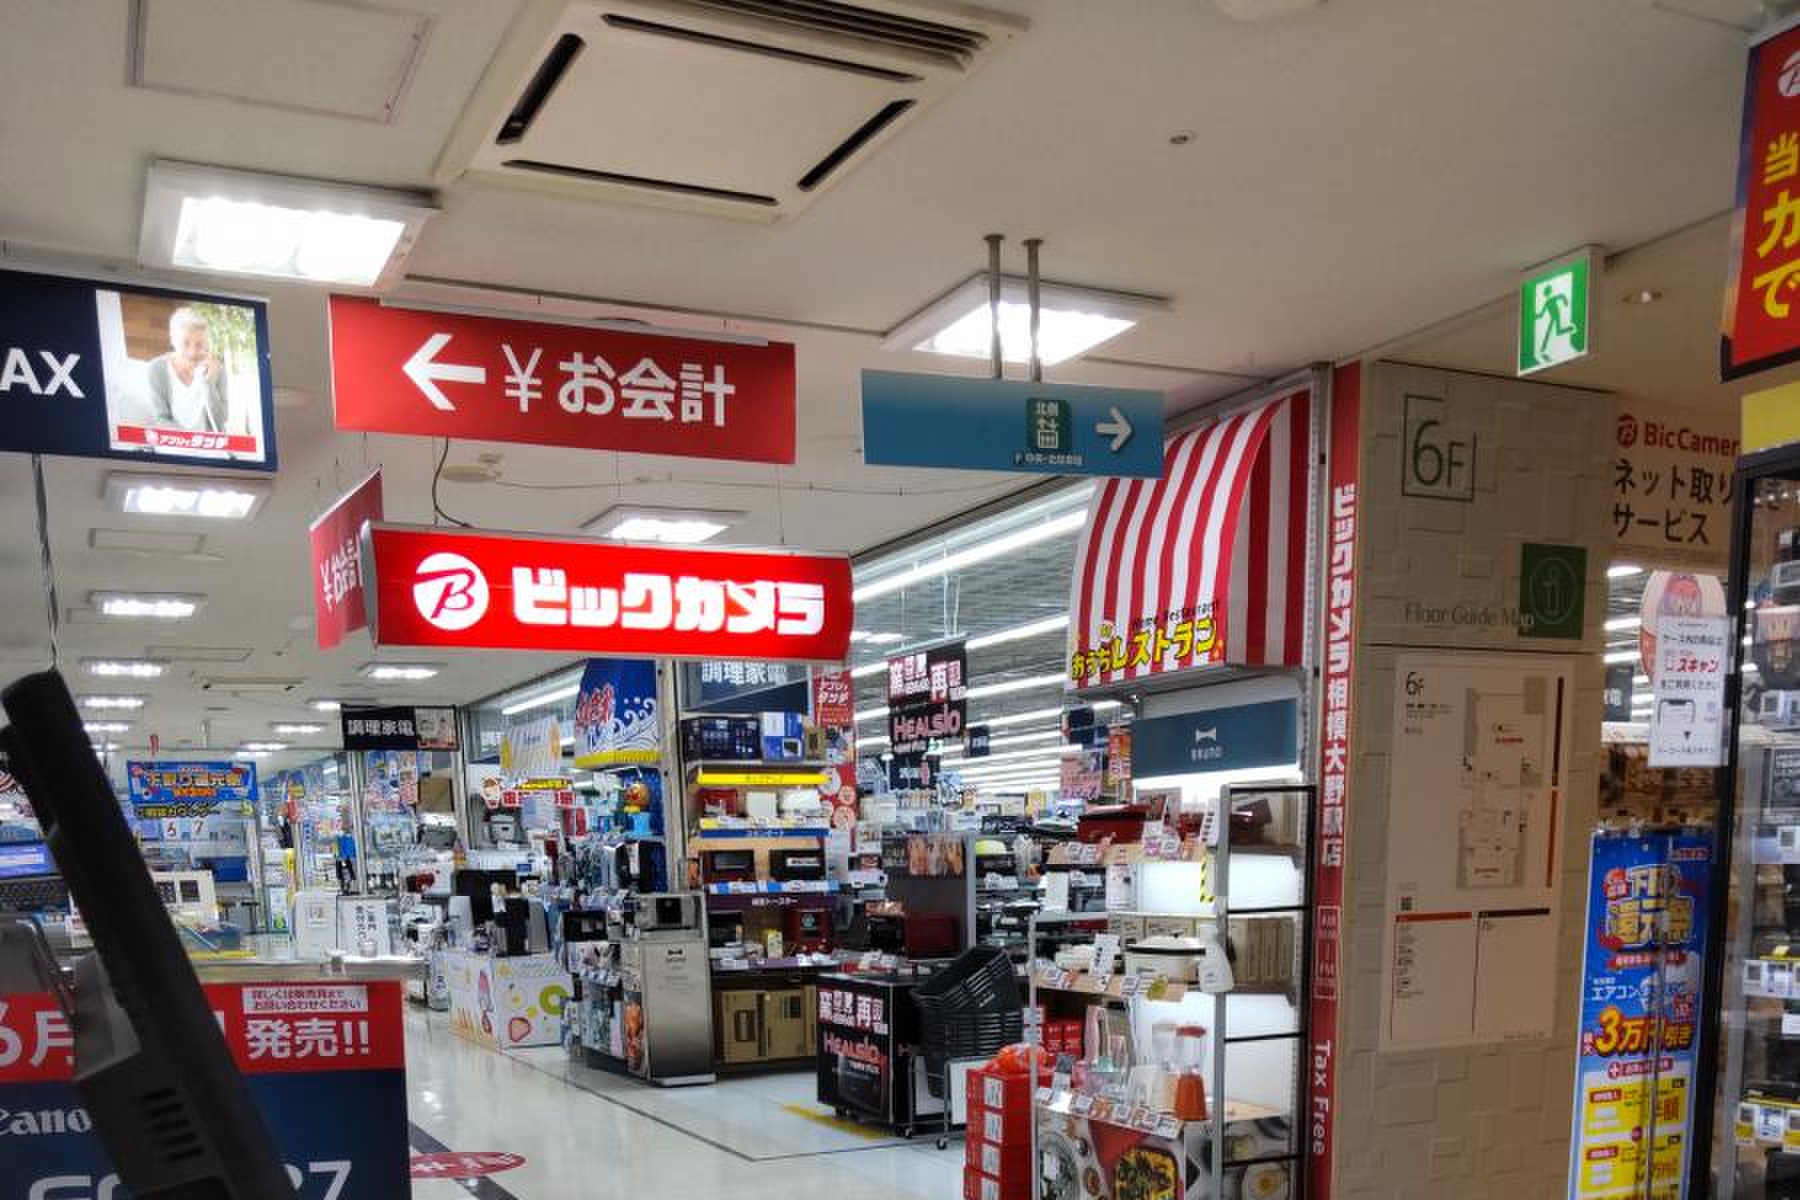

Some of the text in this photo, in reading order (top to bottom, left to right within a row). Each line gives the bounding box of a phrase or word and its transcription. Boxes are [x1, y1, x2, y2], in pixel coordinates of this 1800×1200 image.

[1412, 420, 1466, 487] 6F
[1644, 422, 1740, 457] BicCamer
[1613, 503, 1709, 545] サービス
[511, 566, 824, 635] ビックカメラ
[1072, 617, 1216, 681] おうちレストラン
[1676, 657, 1719, 674] スキャン
[702, 660, 787, 685] 調理家電
[347, 719, 415, 736] 調理家電
[1312, 1040, 1332, 1155] Tax Free
[0, 1107, 93, 1135] Cano
